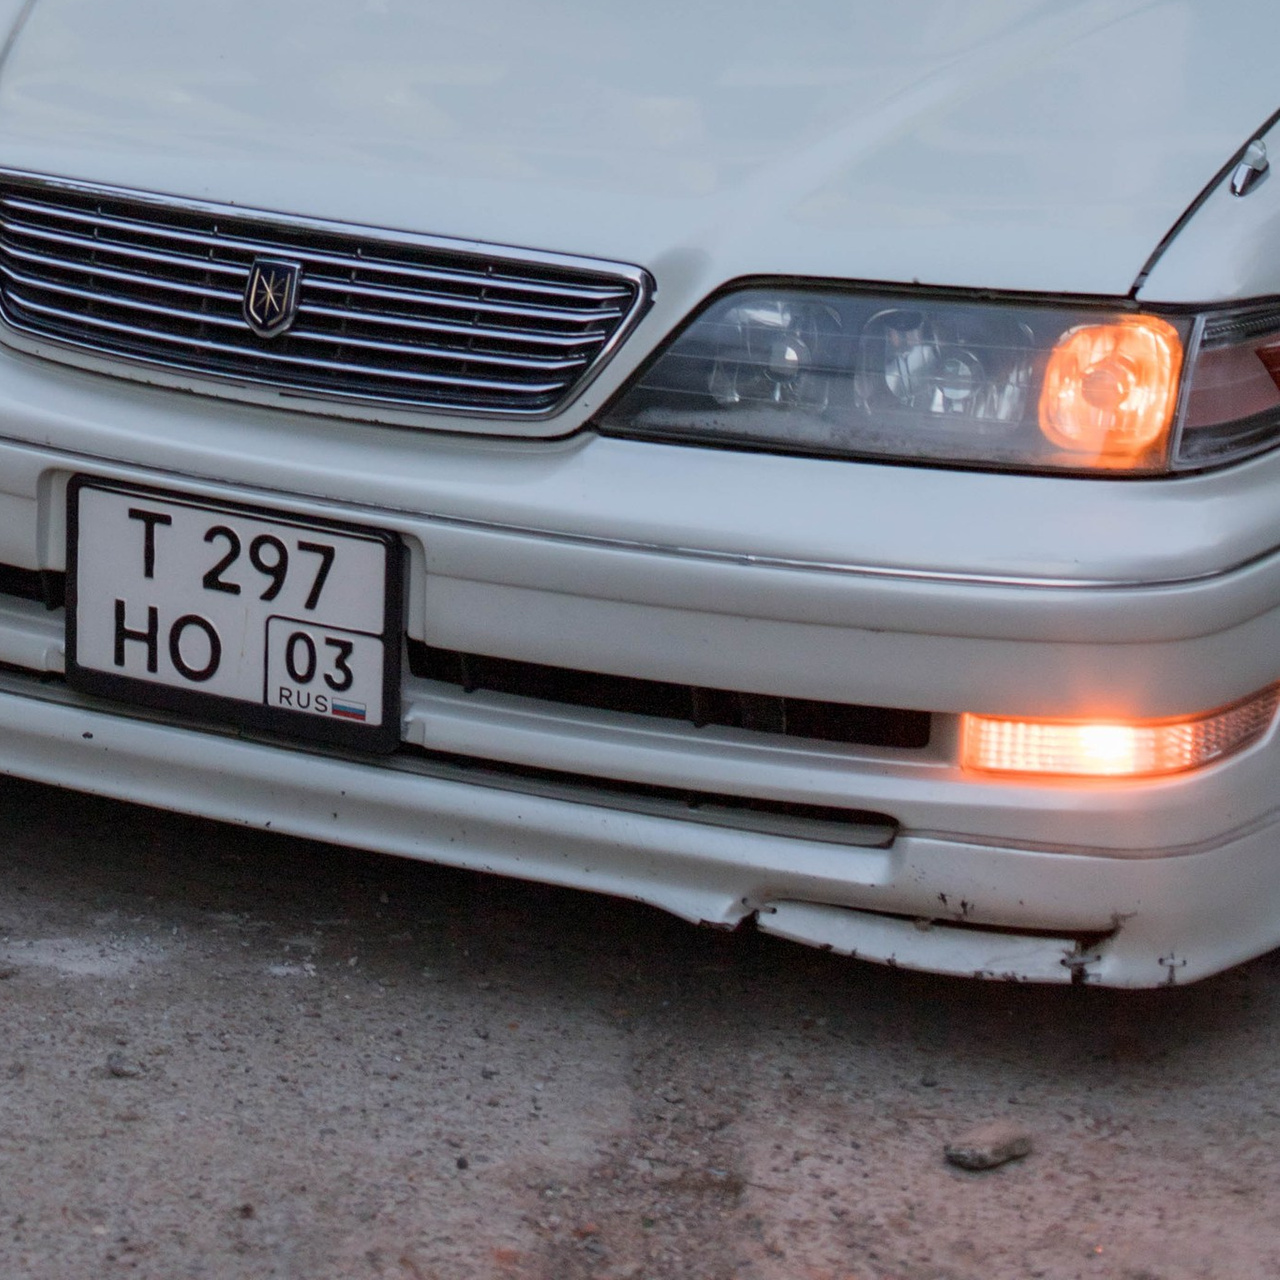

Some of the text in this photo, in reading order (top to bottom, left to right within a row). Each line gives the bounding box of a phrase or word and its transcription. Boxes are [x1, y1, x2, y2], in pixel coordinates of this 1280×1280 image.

[128, 507, 335, 610] T 297
[114, 598, 221, 682] HO
[285, 631, 353, 692] 03
[279, 686, 328, 713] RUS
